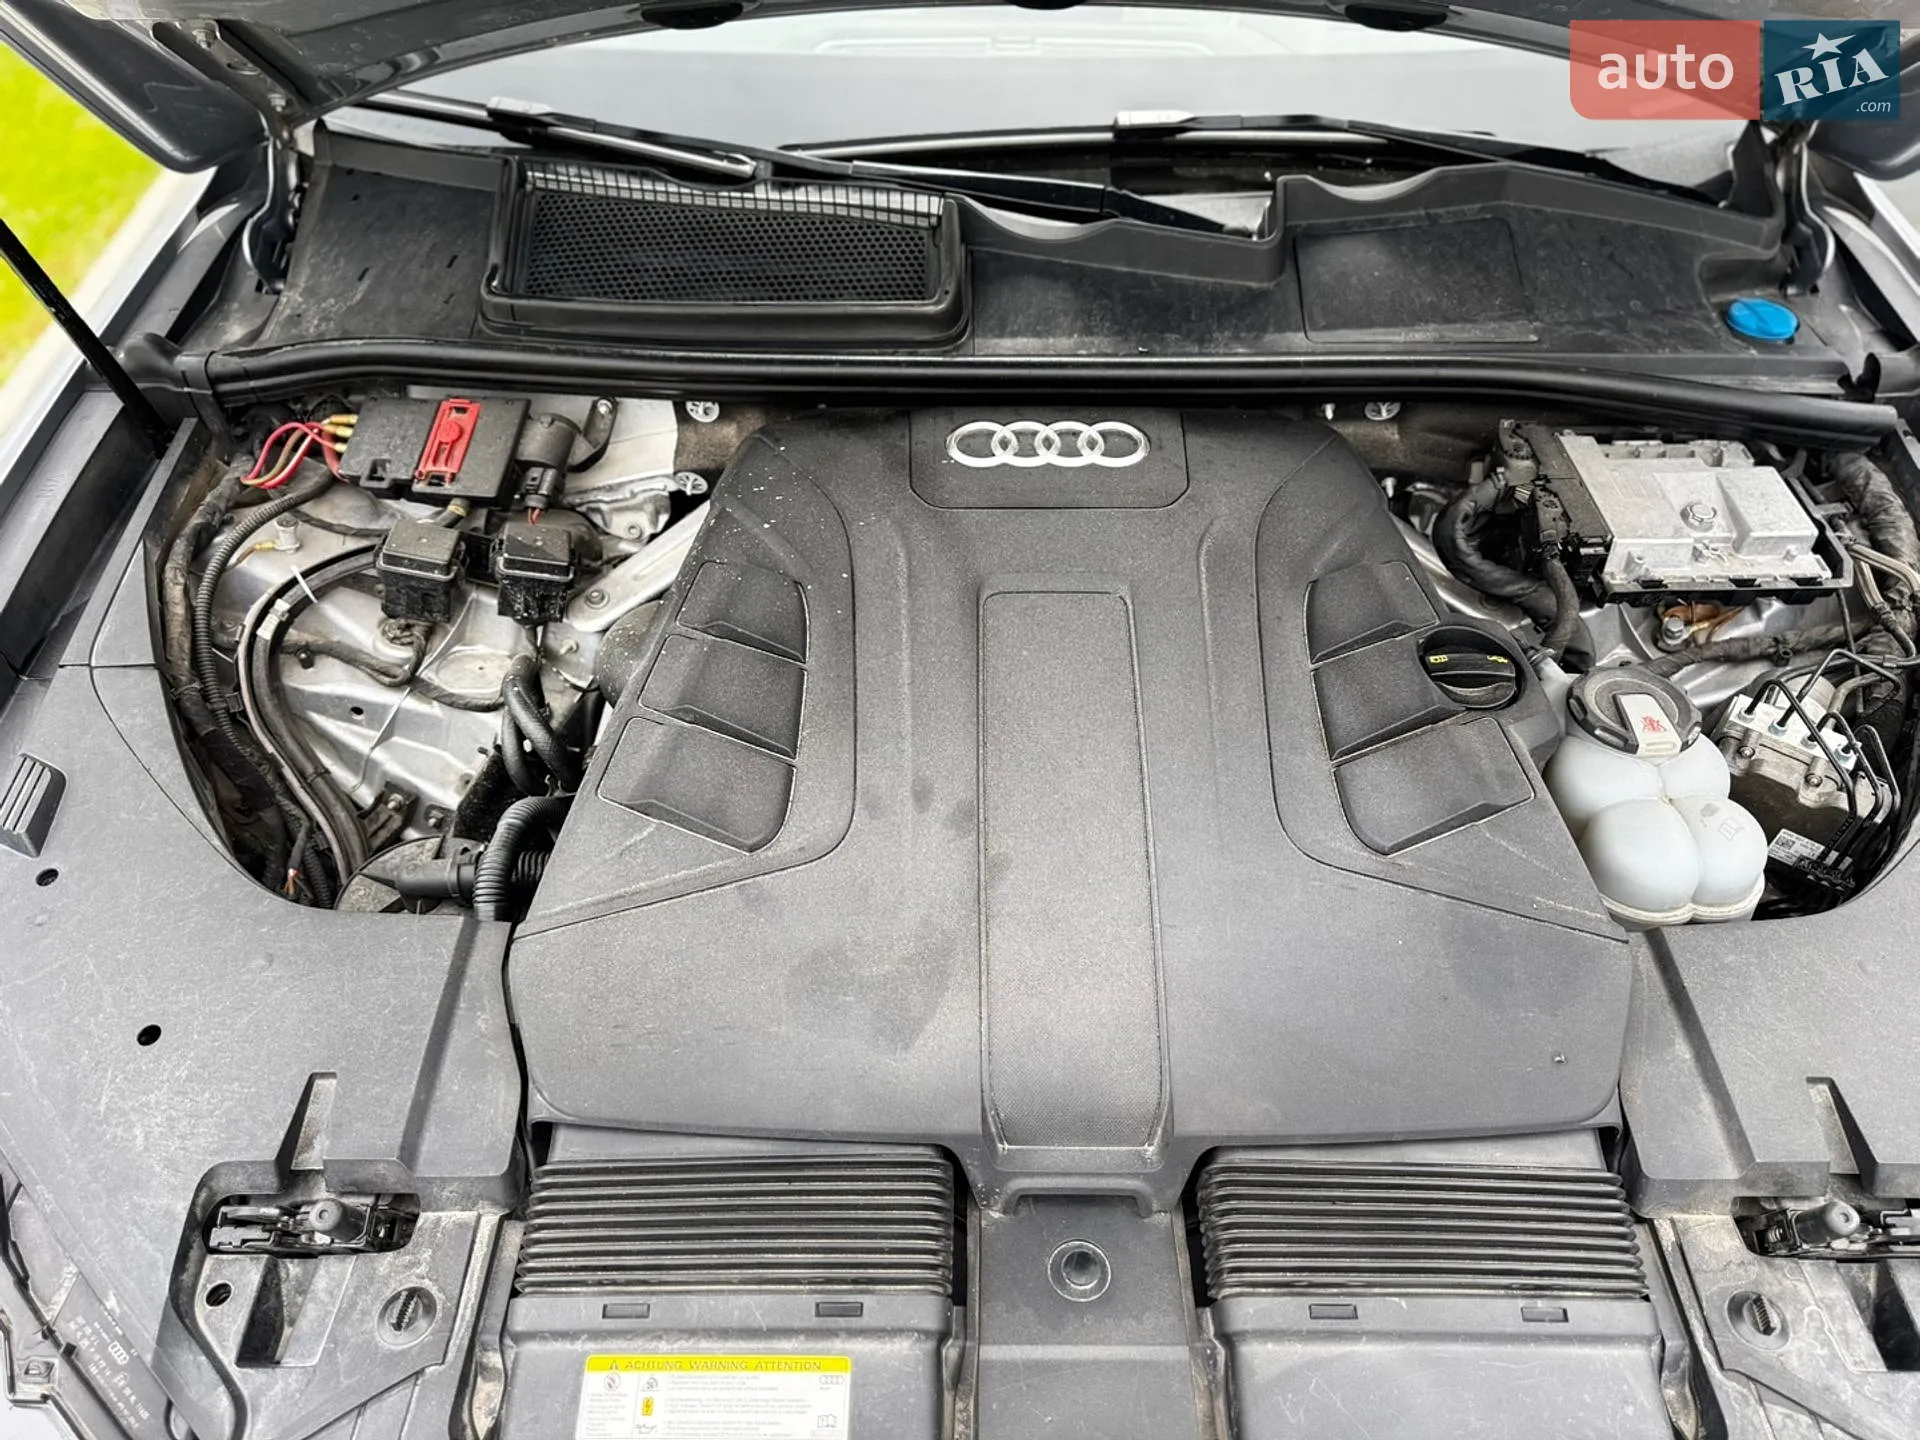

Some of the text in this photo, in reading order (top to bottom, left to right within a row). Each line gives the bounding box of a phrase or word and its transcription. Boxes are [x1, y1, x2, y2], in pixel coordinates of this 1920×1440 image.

[625, 1360, 823, 1371] ACHTUNG WARNING ATTENTION
